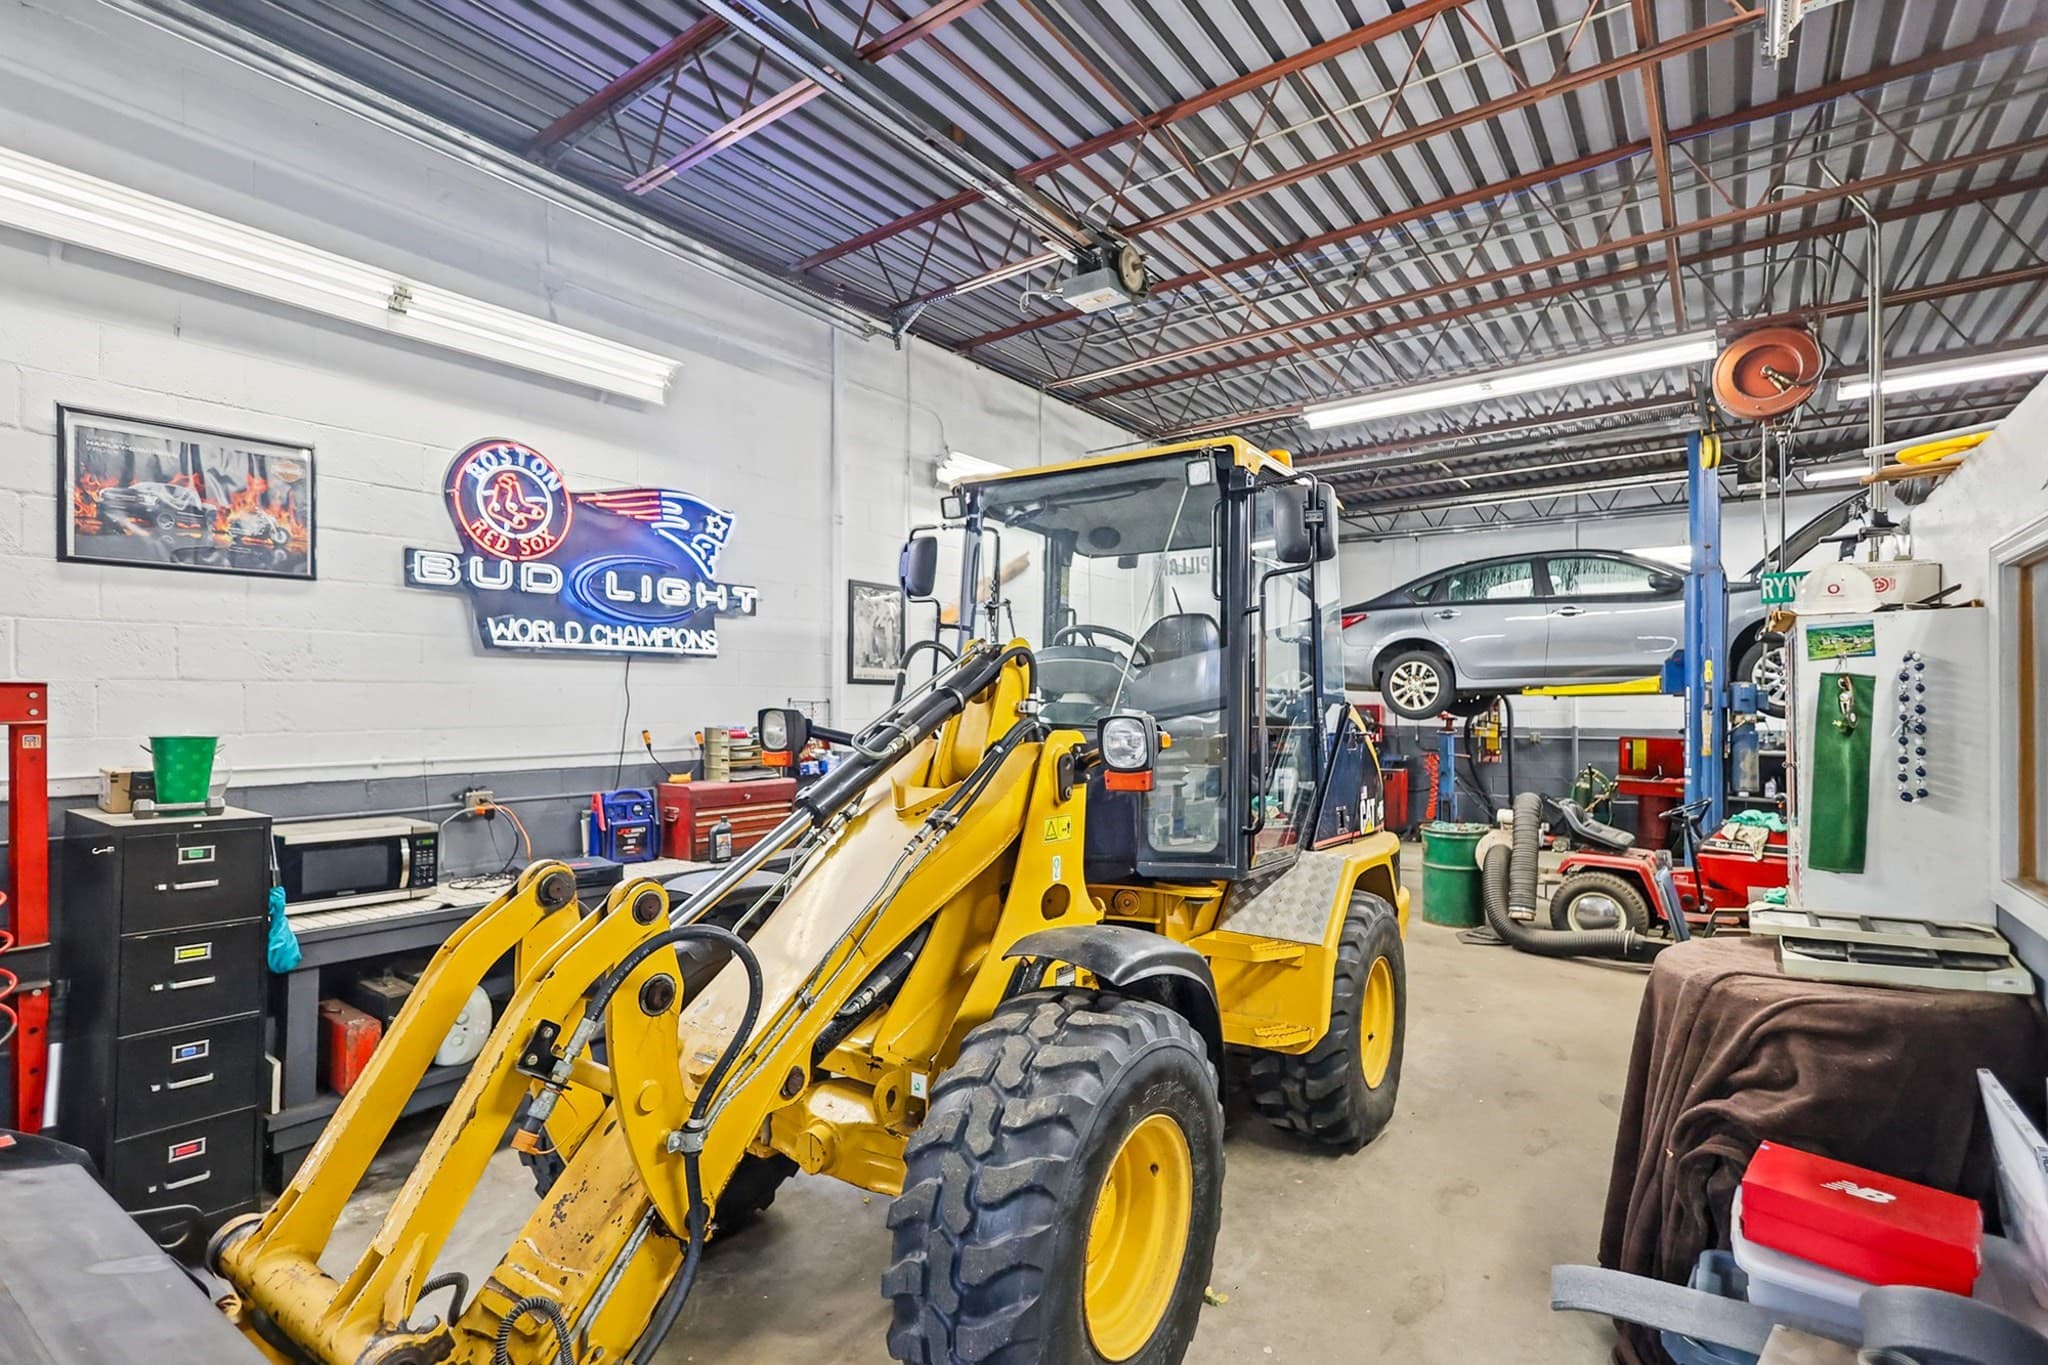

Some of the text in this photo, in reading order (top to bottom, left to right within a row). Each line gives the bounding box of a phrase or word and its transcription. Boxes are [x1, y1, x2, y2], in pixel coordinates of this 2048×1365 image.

[466, 446, 562, 492] BOSTON
[471, 519, 556, 555] RED SOX
[414, 551, 758, 613] BUD LIGHT
[487, 617, 718, 650] WORLD CHAMPIONS
[1360, 798, 1375, 835] CAT
[1820, 1180, 1897, 1203] NB
